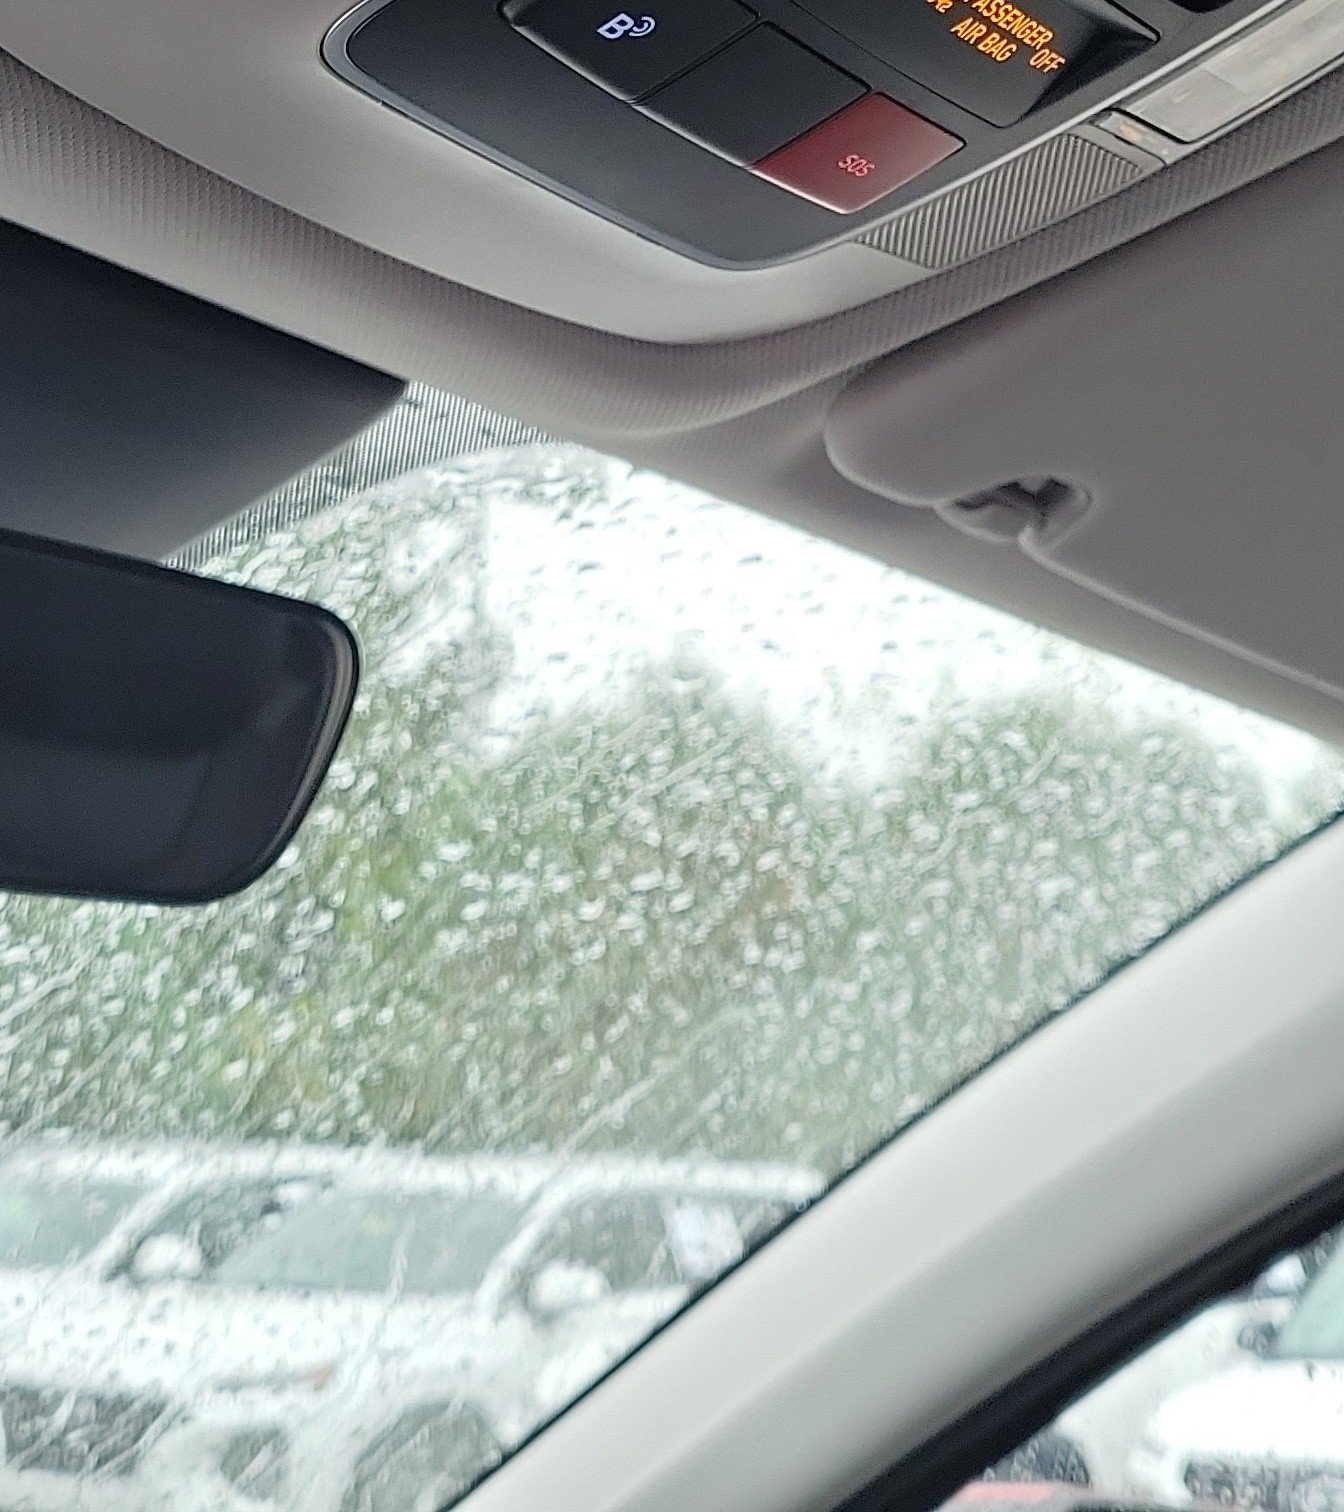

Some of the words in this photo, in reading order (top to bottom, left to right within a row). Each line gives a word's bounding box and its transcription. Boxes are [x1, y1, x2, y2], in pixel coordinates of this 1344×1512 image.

[950, 17, 987, 45] AIR
[977, 32, 1017, 62] BAG
[1030, 48, 1066, 74] OFF
[838, 154, 875, 177] SOS
